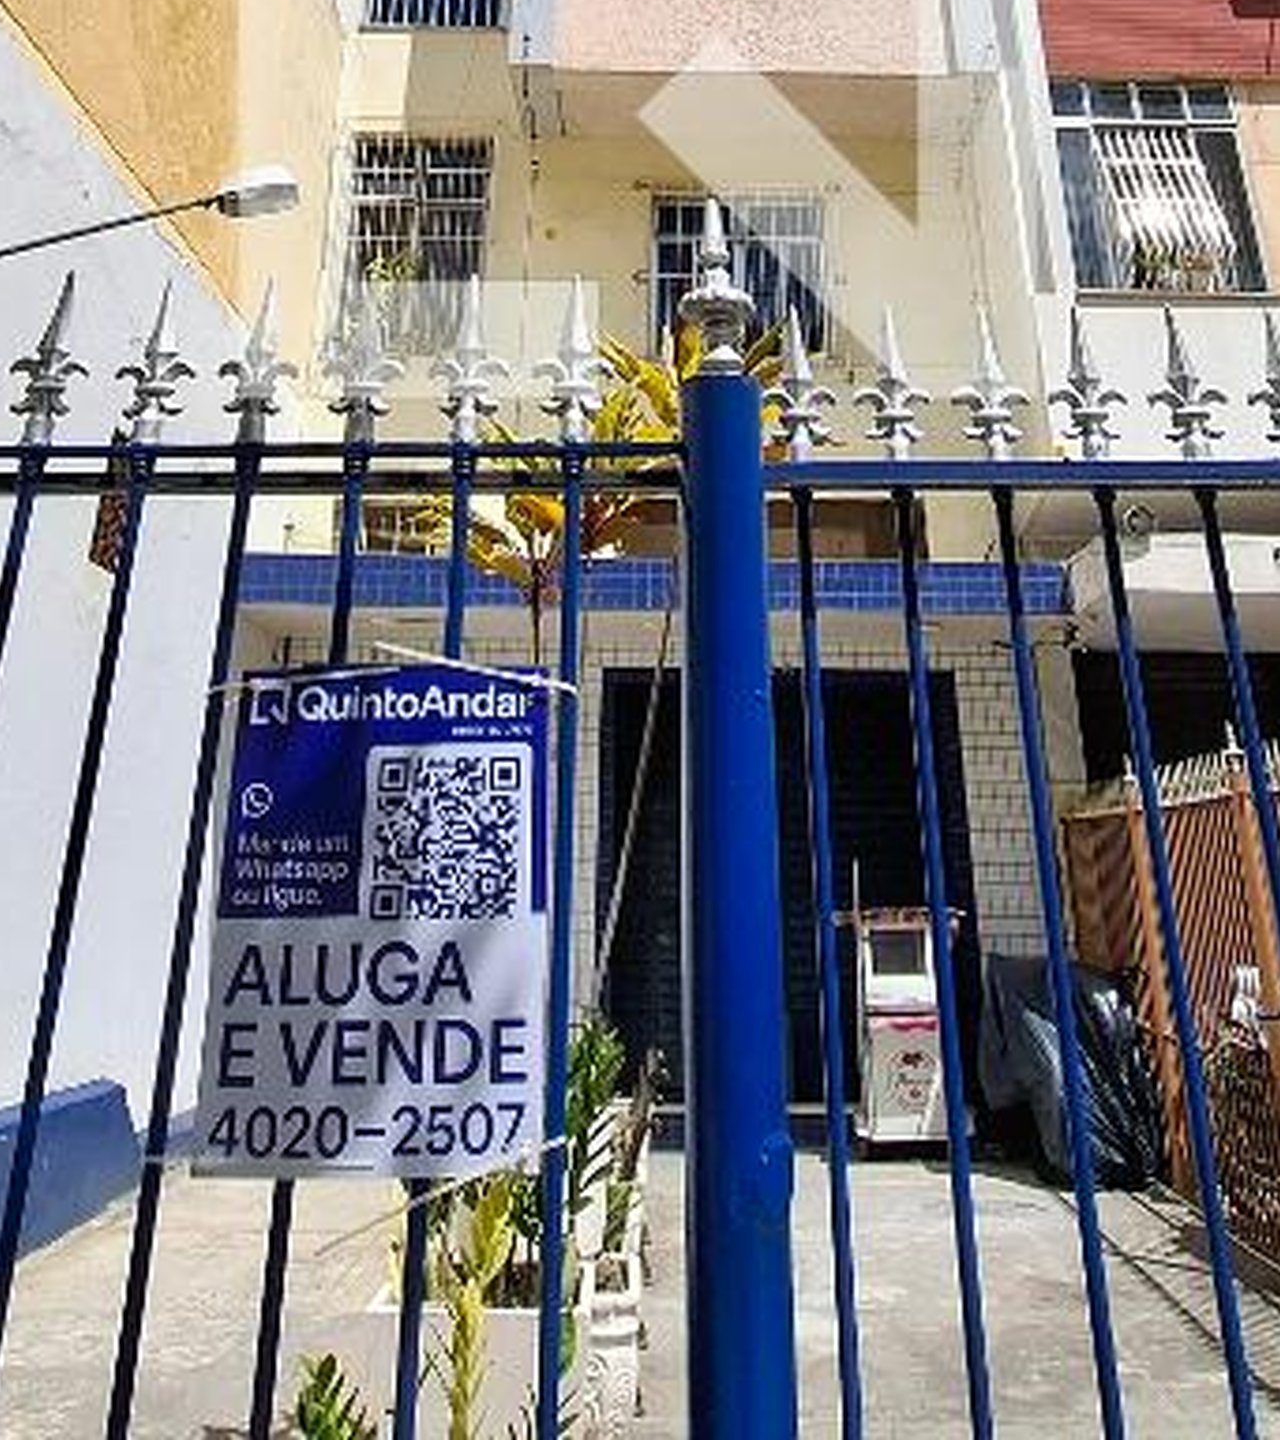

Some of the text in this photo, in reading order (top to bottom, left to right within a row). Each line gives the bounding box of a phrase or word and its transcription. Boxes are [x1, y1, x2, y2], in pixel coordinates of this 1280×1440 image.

[297, 683, 535, 721] QuintoAndar
[223, 940, 474, 1007] ALUGA
[216, 1019, 529, 1088] E VENDE
[207, 1103, 528, 1160] 4020-2507
